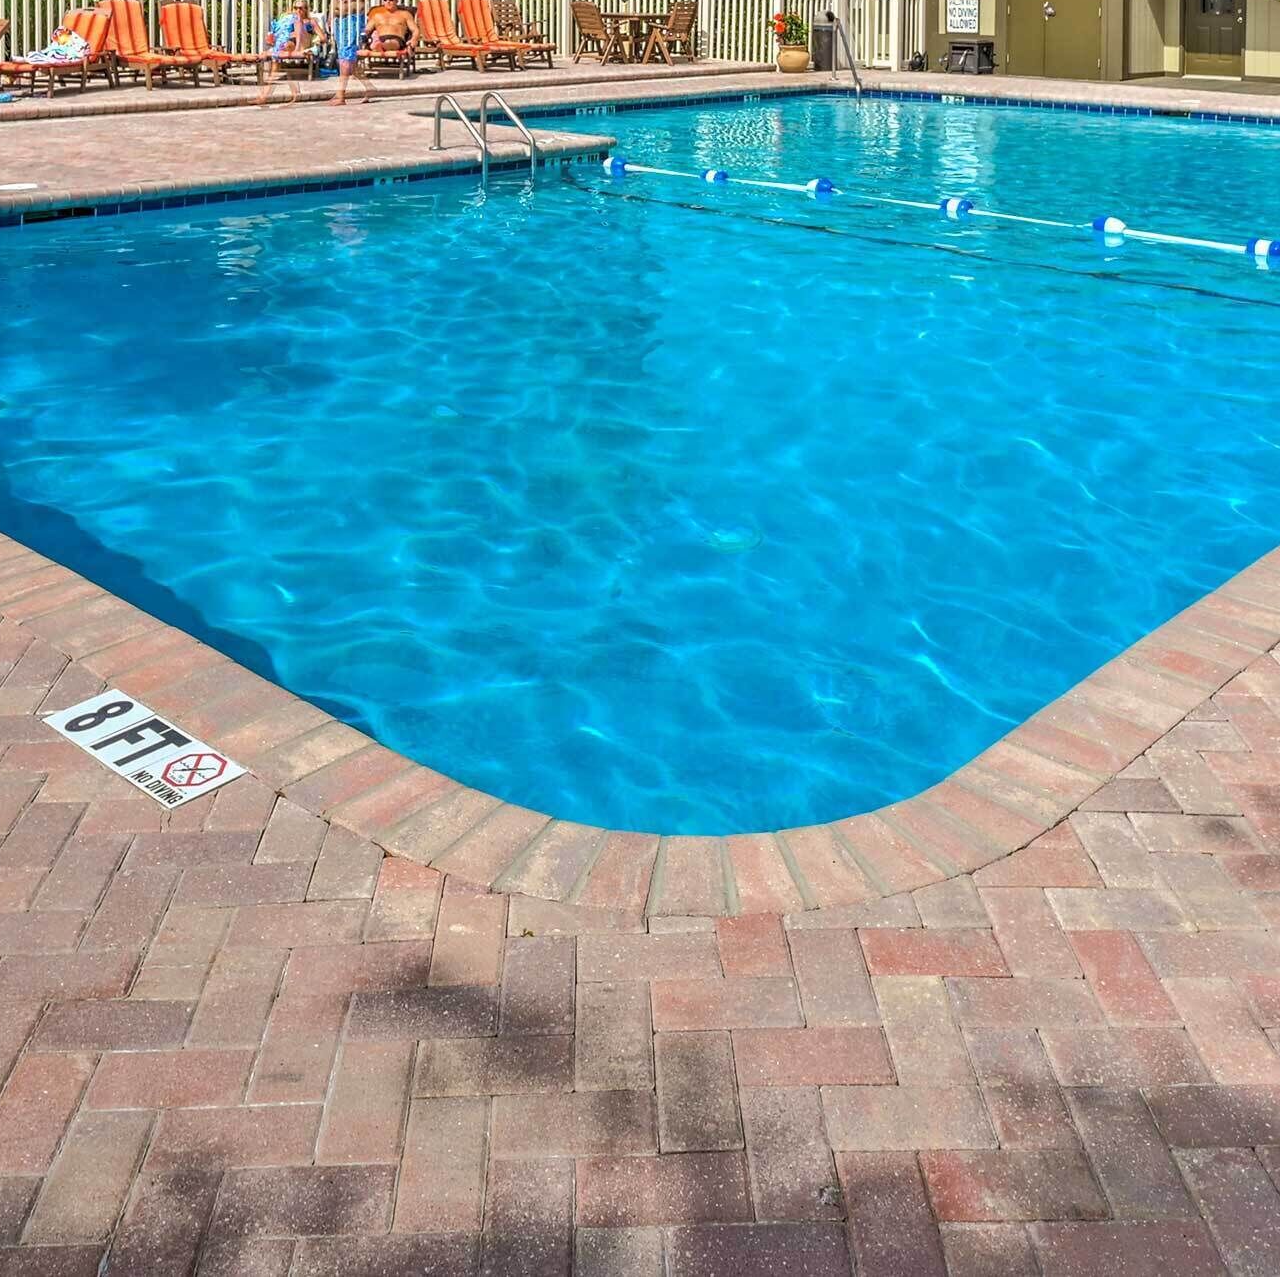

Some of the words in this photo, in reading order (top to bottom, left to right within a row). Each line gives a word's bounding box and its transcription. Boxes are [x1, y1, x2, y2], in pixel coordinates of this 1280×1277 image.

[949, 8, 956, 18] NO
[958, 8, 977, 18] DIVING
[949, 19, 976, 29] ALLOWED
[64, 700, 134, 732] 8
[89, 718, 192, 767] FT
[131, 770, 153, 783] NO
[144, 780, 183, 804] DIVING
